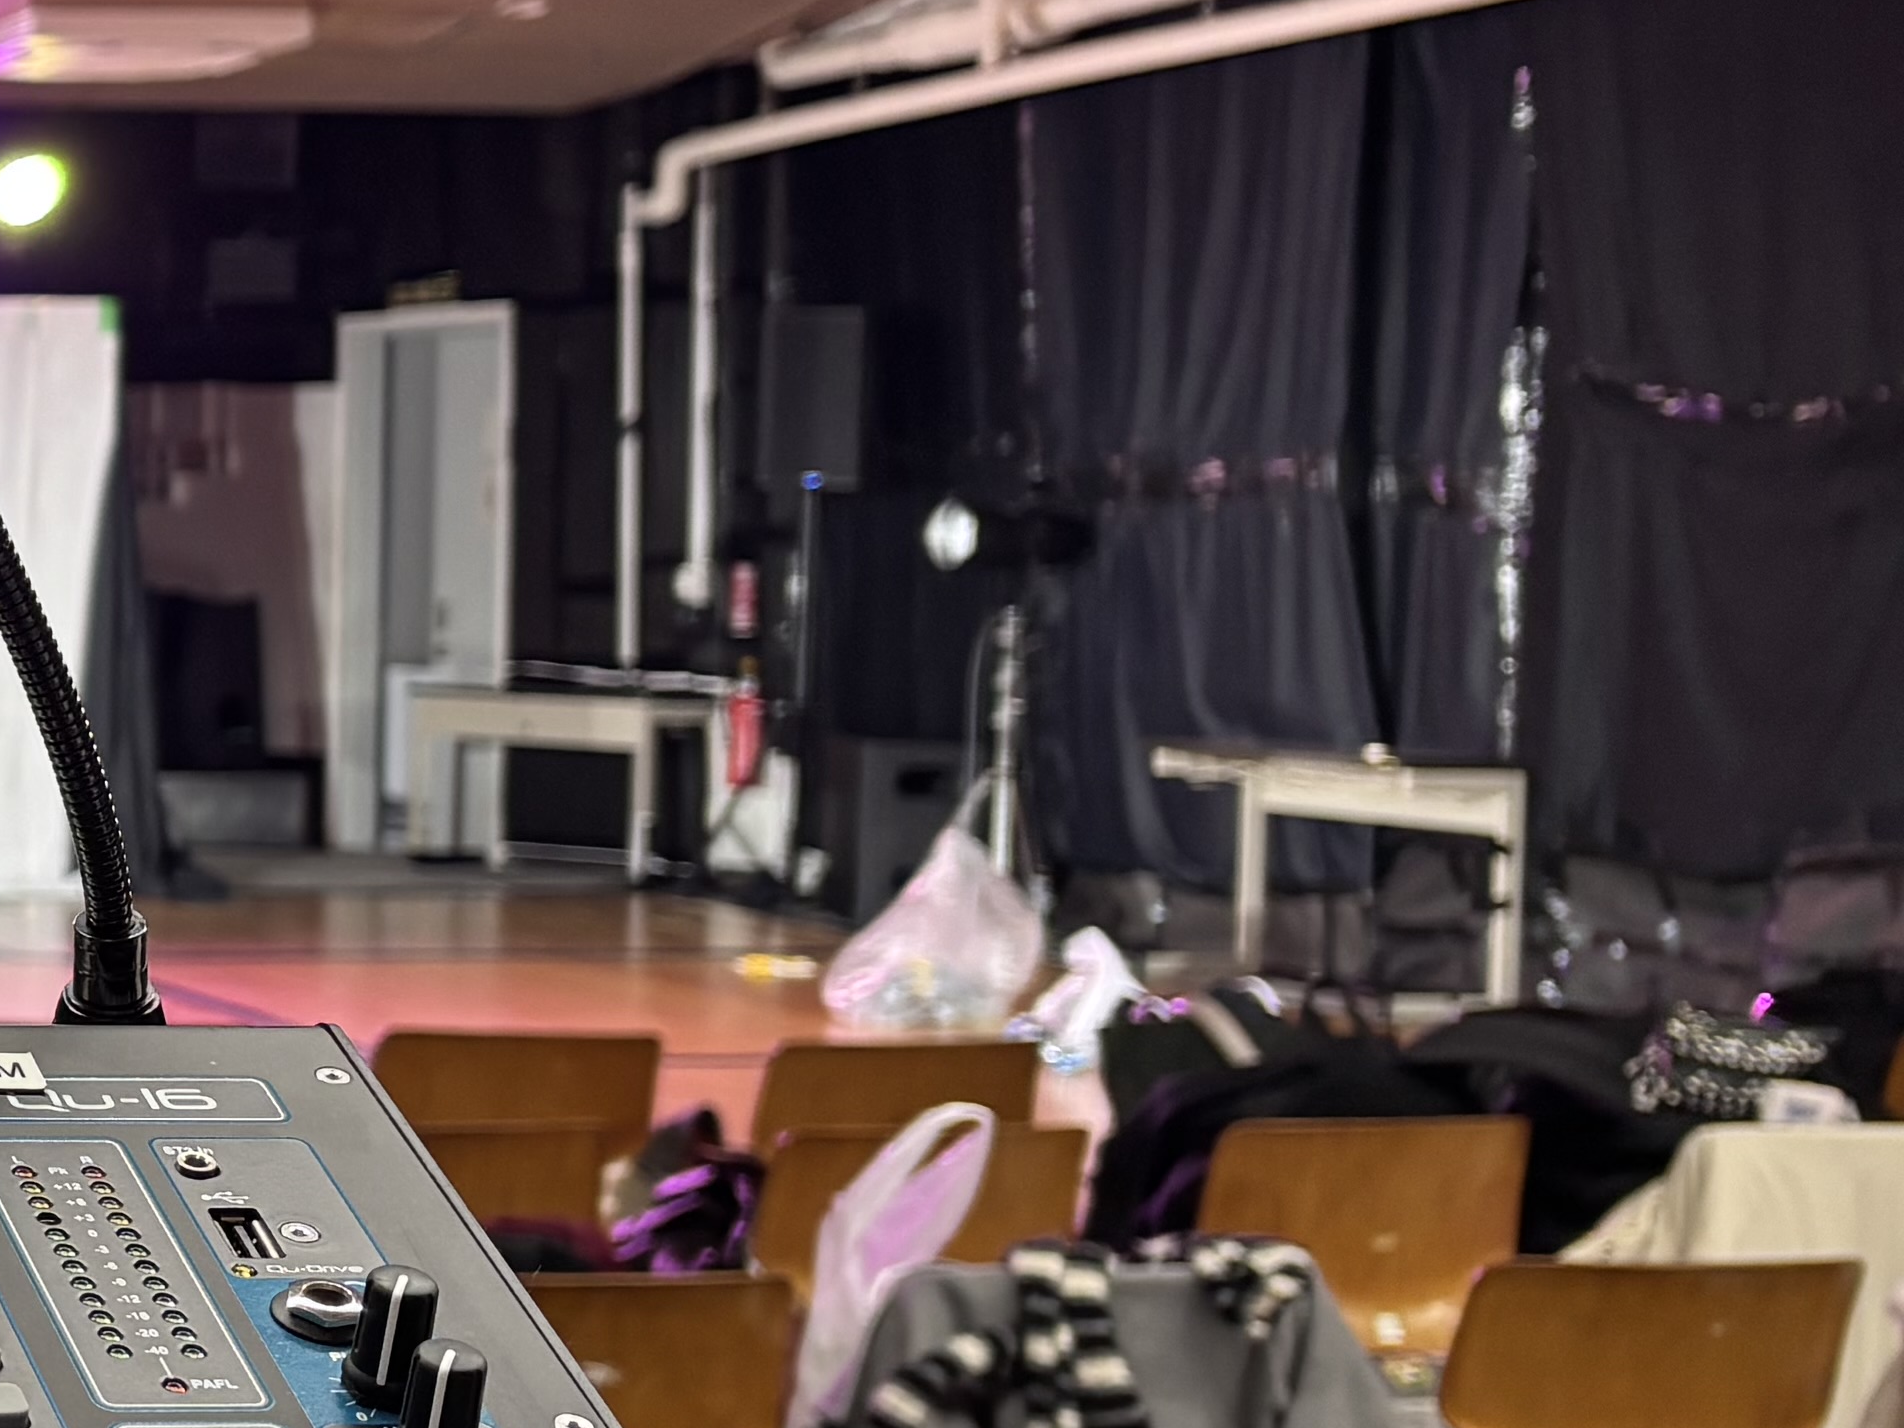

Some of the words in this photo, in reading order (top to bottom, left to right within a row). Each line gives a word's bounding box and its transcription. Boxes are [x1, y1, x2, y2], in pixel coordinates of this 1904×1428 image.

[53, 1182, 82, 1191] +12
[74, 1213, 95, 1222] +3
[265, 1264, 364, 1274] Qu-Drive
[117, 1294, 141, 1304] -12
[135, 1328, 159, 1338] -20
[144, 1346, 169, 1355] -40
[190, 1379, 239, 1390] PAFL
[355, 1411, 368, 1422] 0
